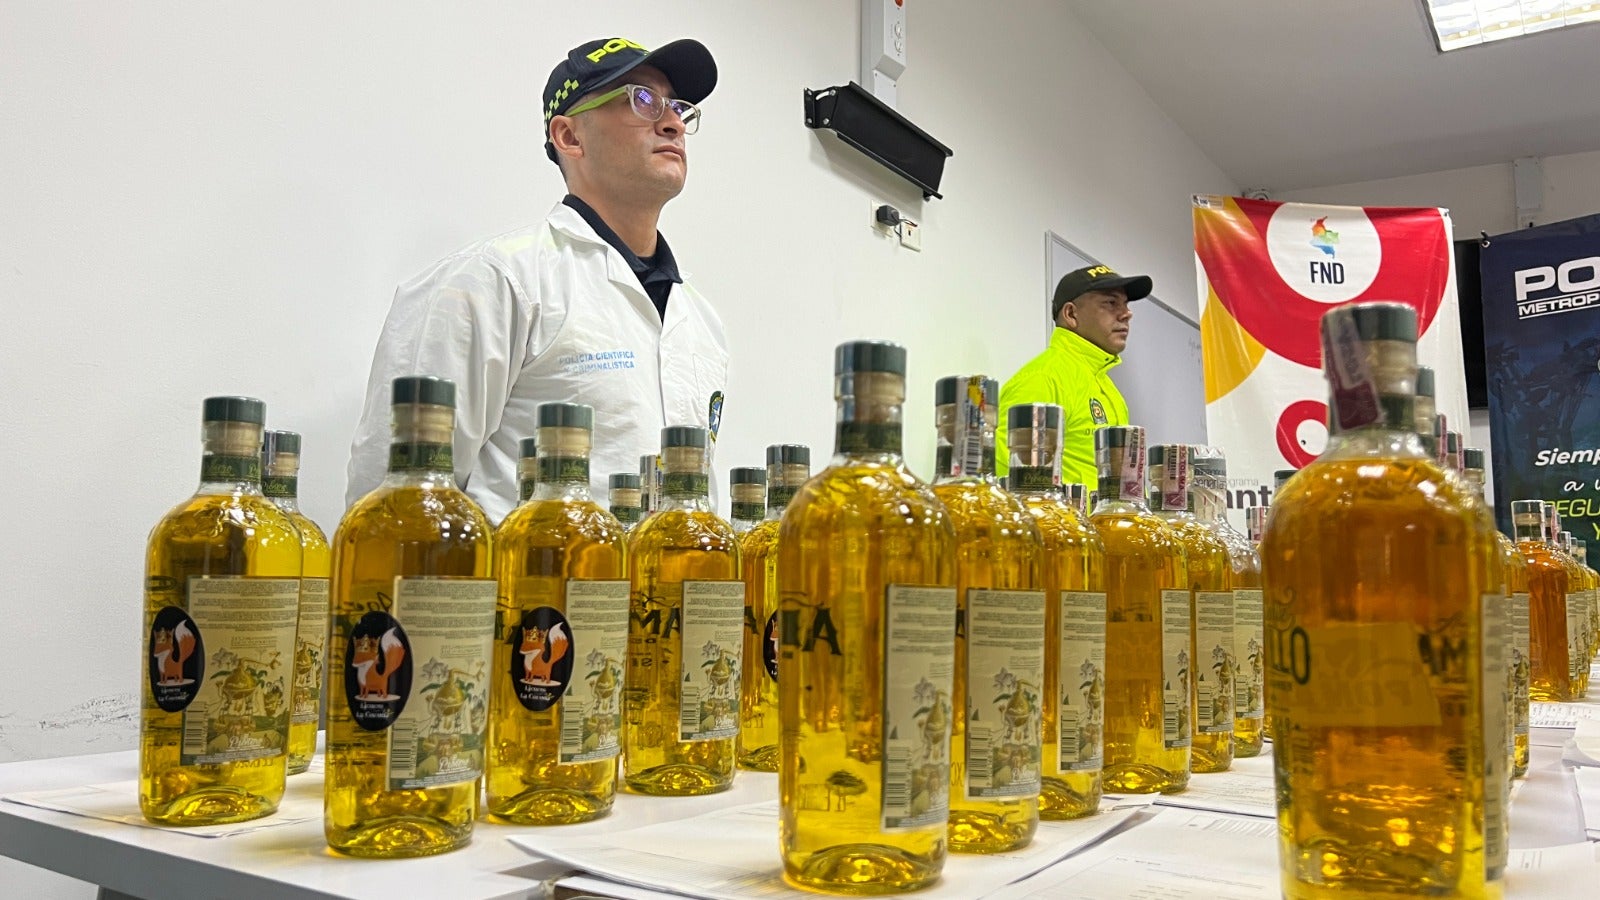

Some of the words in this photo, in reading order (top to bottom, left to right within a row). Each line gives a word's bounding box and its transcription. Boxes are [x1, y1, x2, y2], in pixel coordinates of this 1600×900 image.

[1309, 261, 1345, 284] FND
[1514, 256, 1600, 301] PO
[1518, 293, 1600, 316] METROP
[1563, 480, 1585, 492] a
